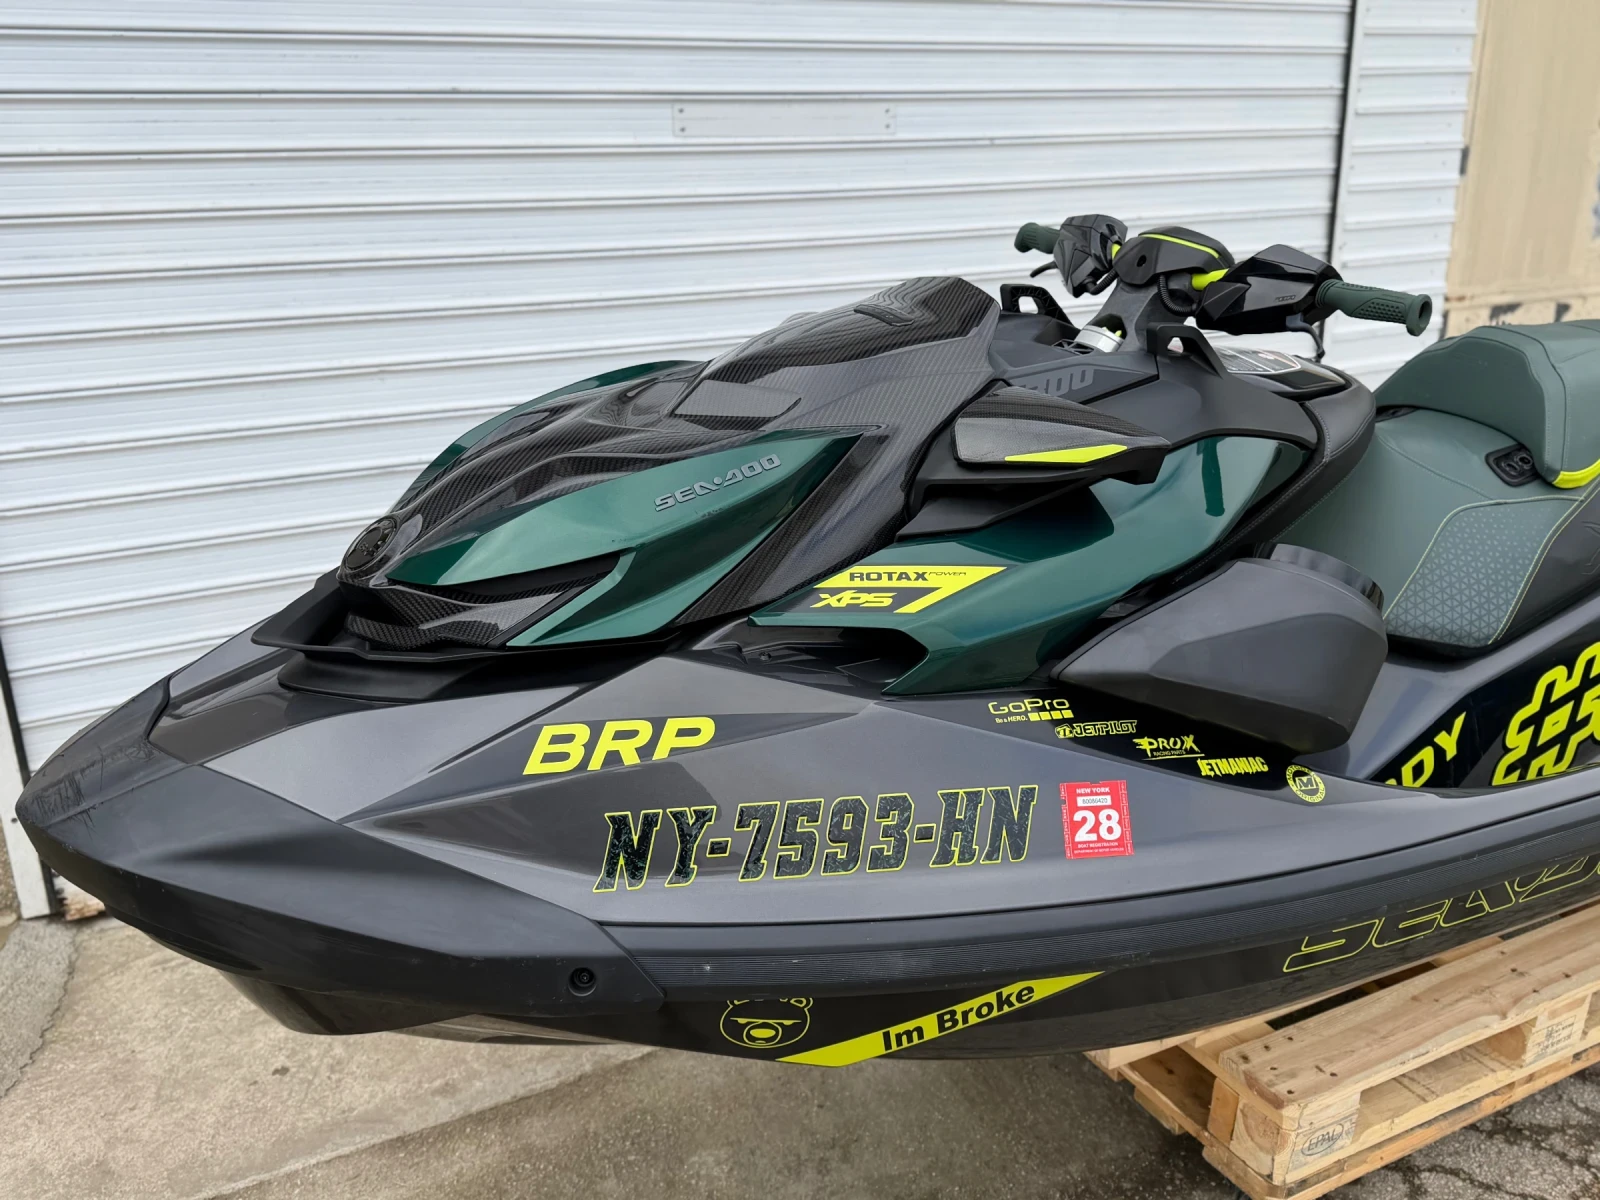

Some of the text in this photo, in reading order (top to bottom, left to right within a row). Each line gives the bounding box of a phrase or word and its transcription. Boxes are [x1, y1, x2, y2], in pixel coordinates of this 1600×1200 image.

[849, 571, 929, 582] ROTAX
[809, 590, 898, 608] XPS
[988, 698, 1070, 715] GoPro
[1072, 720, 1137, 737] JETPILOT
[522, 716, 716, 776] BRP
[1385, 711, 1466, 788] DY
[1197, 757, 1269, 778] JETMANIAC
[1073, 808, 1122, 843] 28
[592, 785, 1039, 893] NY-7593-HN
[882, 985, 1035, 1052] Im Broke
[1308, 1128, 1338, 1152] EPAL
